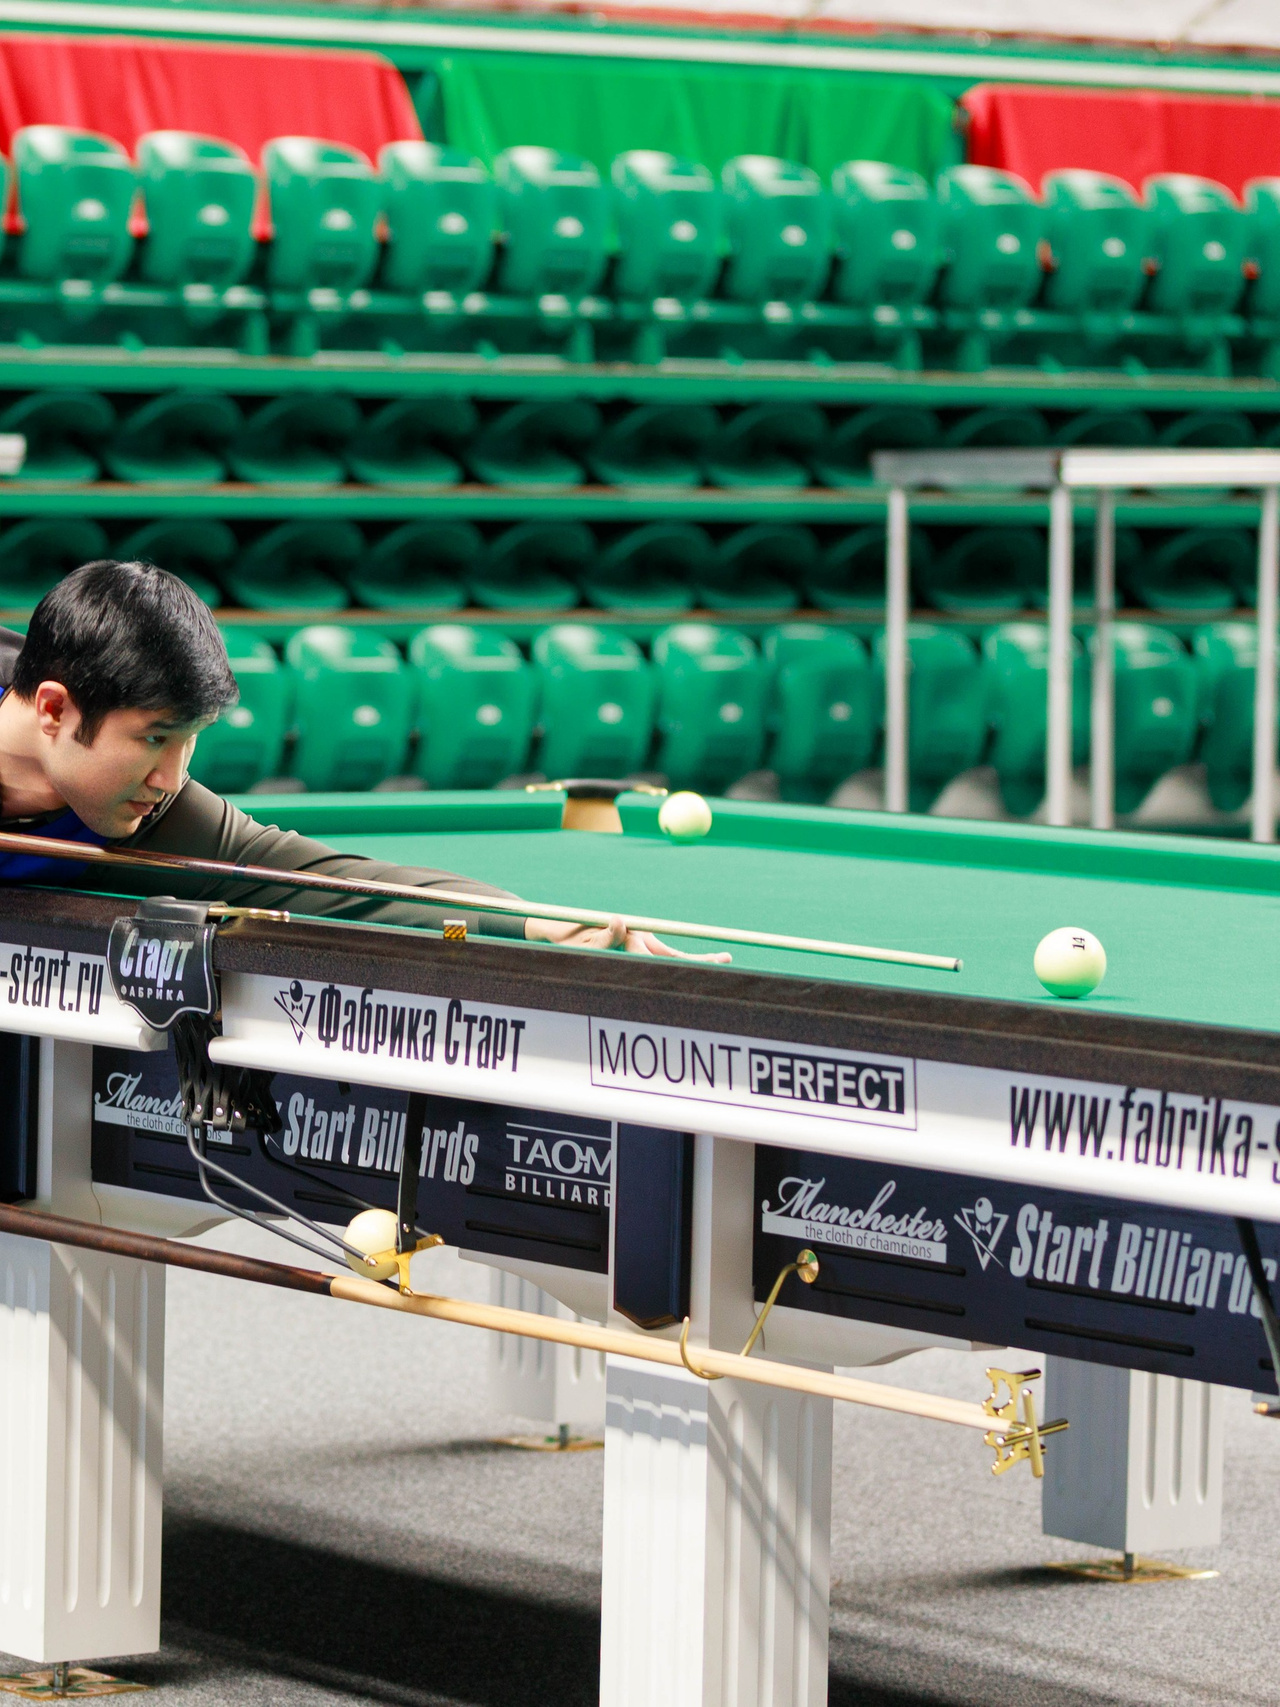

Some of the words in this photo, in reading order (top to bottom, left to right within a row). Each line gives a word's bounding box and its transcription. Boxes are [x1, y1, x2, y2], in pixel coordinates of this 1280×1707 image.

[120, 927, 194, 988] Старт
[1072, 936, 1085, 950] 14
[120, 984, 184, 1001] ФАБРИКА
[318, 984, 437, 1062] Фабрика
[444, 999, 526, 1073] Старт
[94, 1072, 183, 1118] Manch
[599, 1029, 741, 1091] MOUNT
[750, 1053, 903, 1113] PERFECT
[126, 1112, 141, 1125] the
[142, 1116, 163, 1131] cloth
[165, 1121, 176, 1133] of
[283, 1092, 356, 1164] Start
[357, 1107, 479, 1186] Billards
[762, 1177, 948, 1242] Manchester
[805, 1224, 823, 1240] the
[825, 1227, 853, 1245] cloth
[856, 1232, 869, 1248] of
[870, 1237, 932, 1259] champions
[1010, 1203, 1108, 1289] Start
